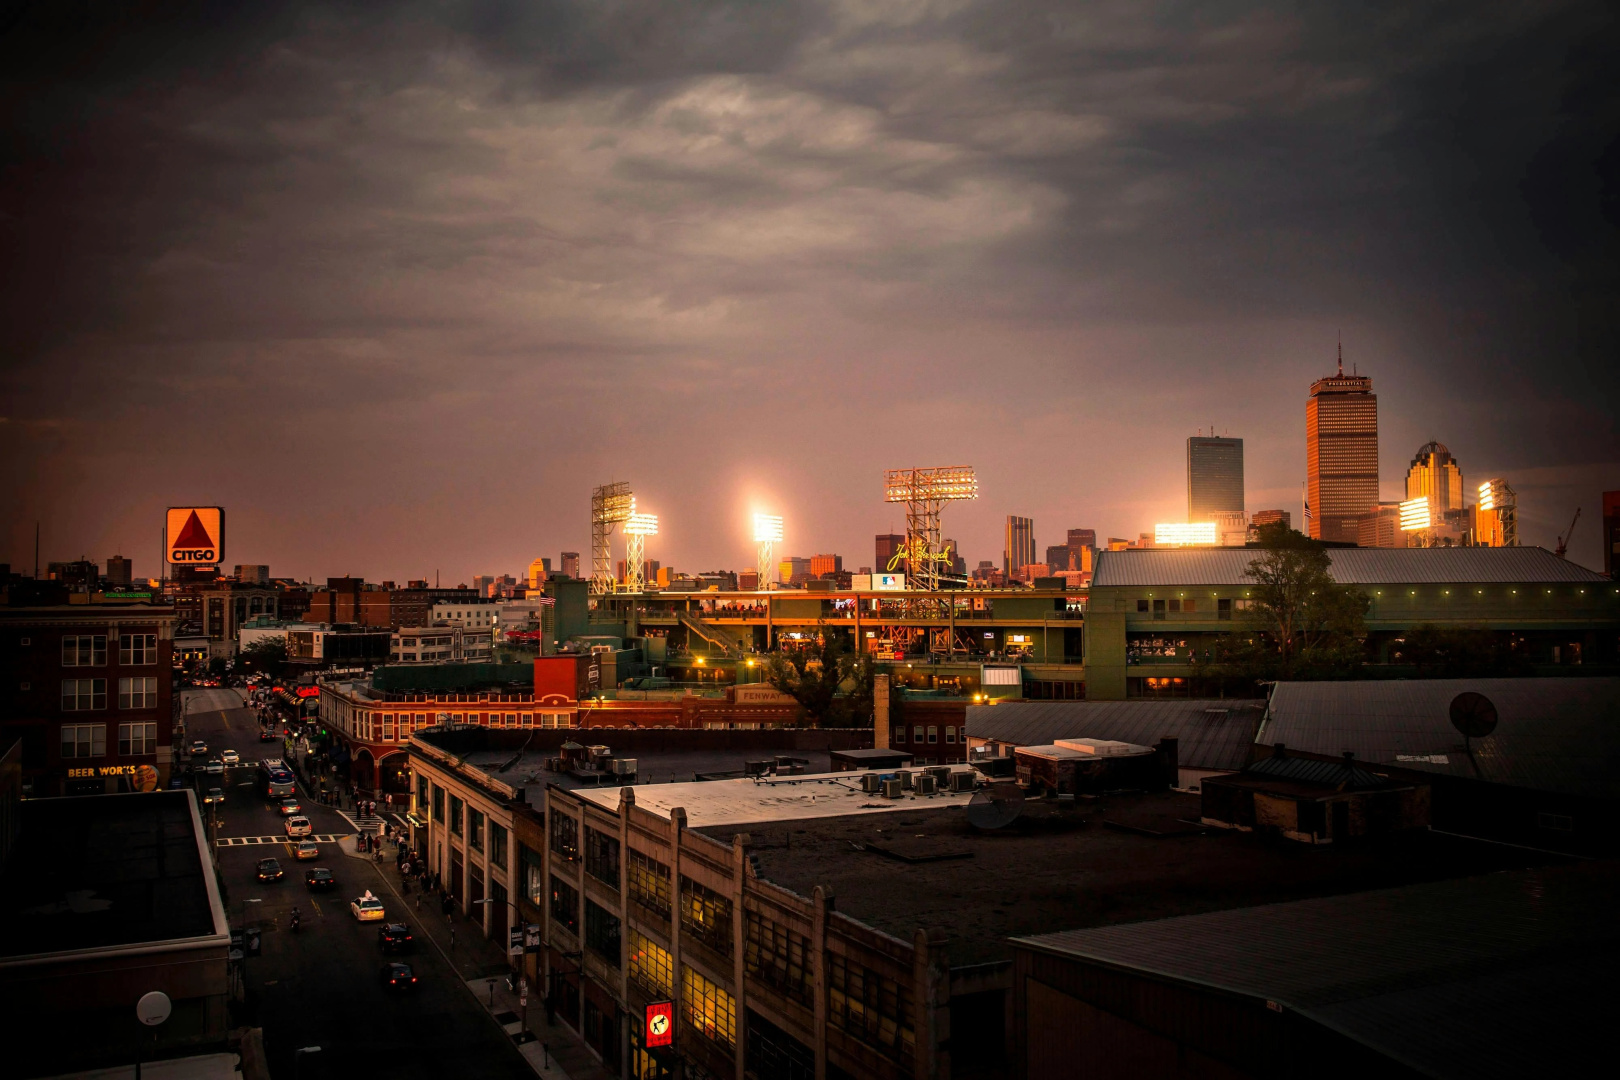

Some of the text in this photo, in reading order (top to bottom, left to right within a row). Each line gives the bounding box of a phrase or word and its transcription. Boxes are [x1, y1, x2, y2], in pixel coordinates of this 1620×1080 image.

[172, 550, 215, 561] CITGO
[886, 543, 912, 571] Joh
[743, 692, 781, 700] FENWAY
[68, 768, 95, 778] BEER
